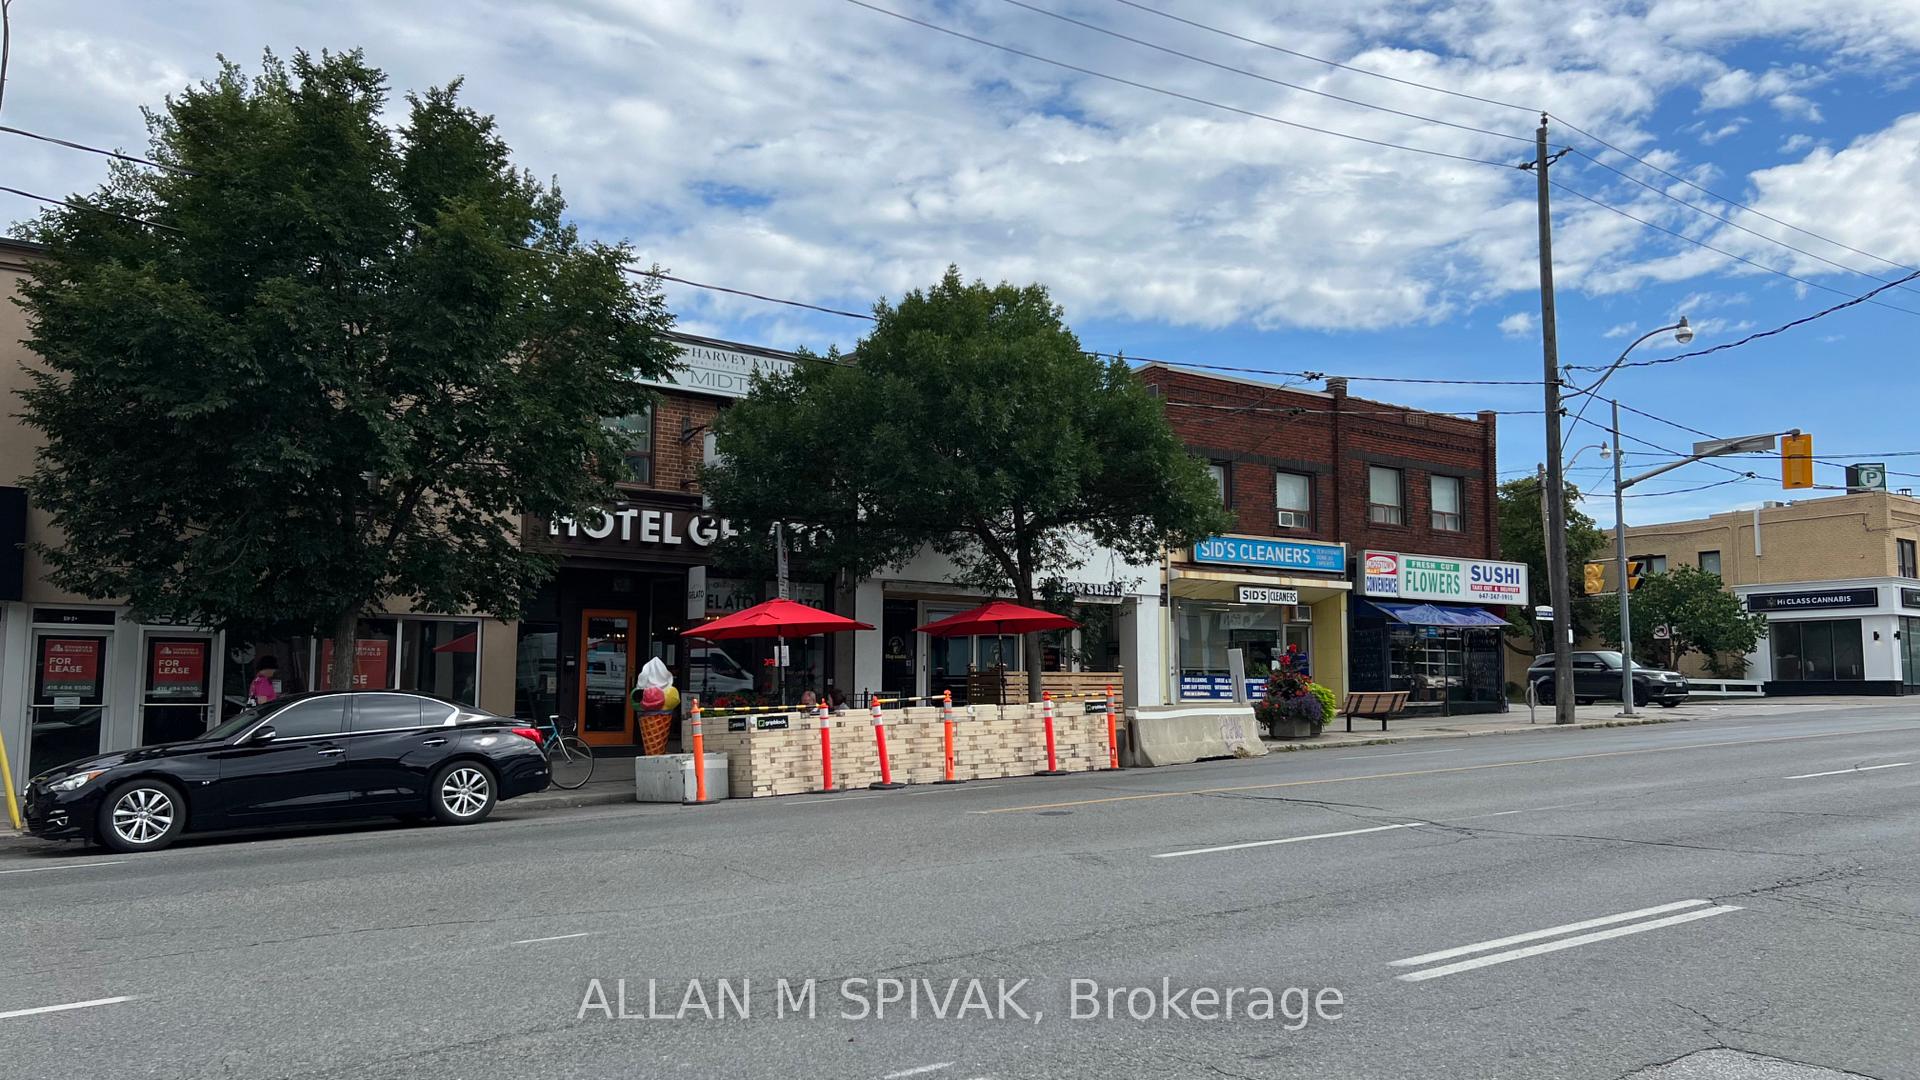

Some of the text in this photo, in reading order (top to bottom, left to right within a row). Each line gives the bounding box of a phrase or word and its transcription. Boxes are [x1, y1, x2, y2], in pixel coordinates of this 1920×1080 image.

[692, 347, 749, 366] HARVEY
[691, 370, 748, 391] MIDT
[1866, 471, 1878, 483] P
[550, 506, 682, 545] HOTEL
[1201, 540, 1311, 564] SID'S CLEANERS
[1411, 560, 1454, 571] FRESH CUT
[1471, 564, 1520, 585] SUSHI
[1366, 576, 1397, 593] CONVENIENCE
[1406, 570, 1460, 595] FLOWERS
[688, 590, 705, 599] GELATO
[1242, 589, 1297, 602] SID'S CLEANERS
[1786, 597, 1811, 605] CLASS
[1812, 595, 1852, 604] CANNABIS
[707, 594, 753, 610] ELATO
[49, 657, 72, 665] FOR
[159, 659, 180, 667] FOR
[49, 665, 83, 673] LEASE
